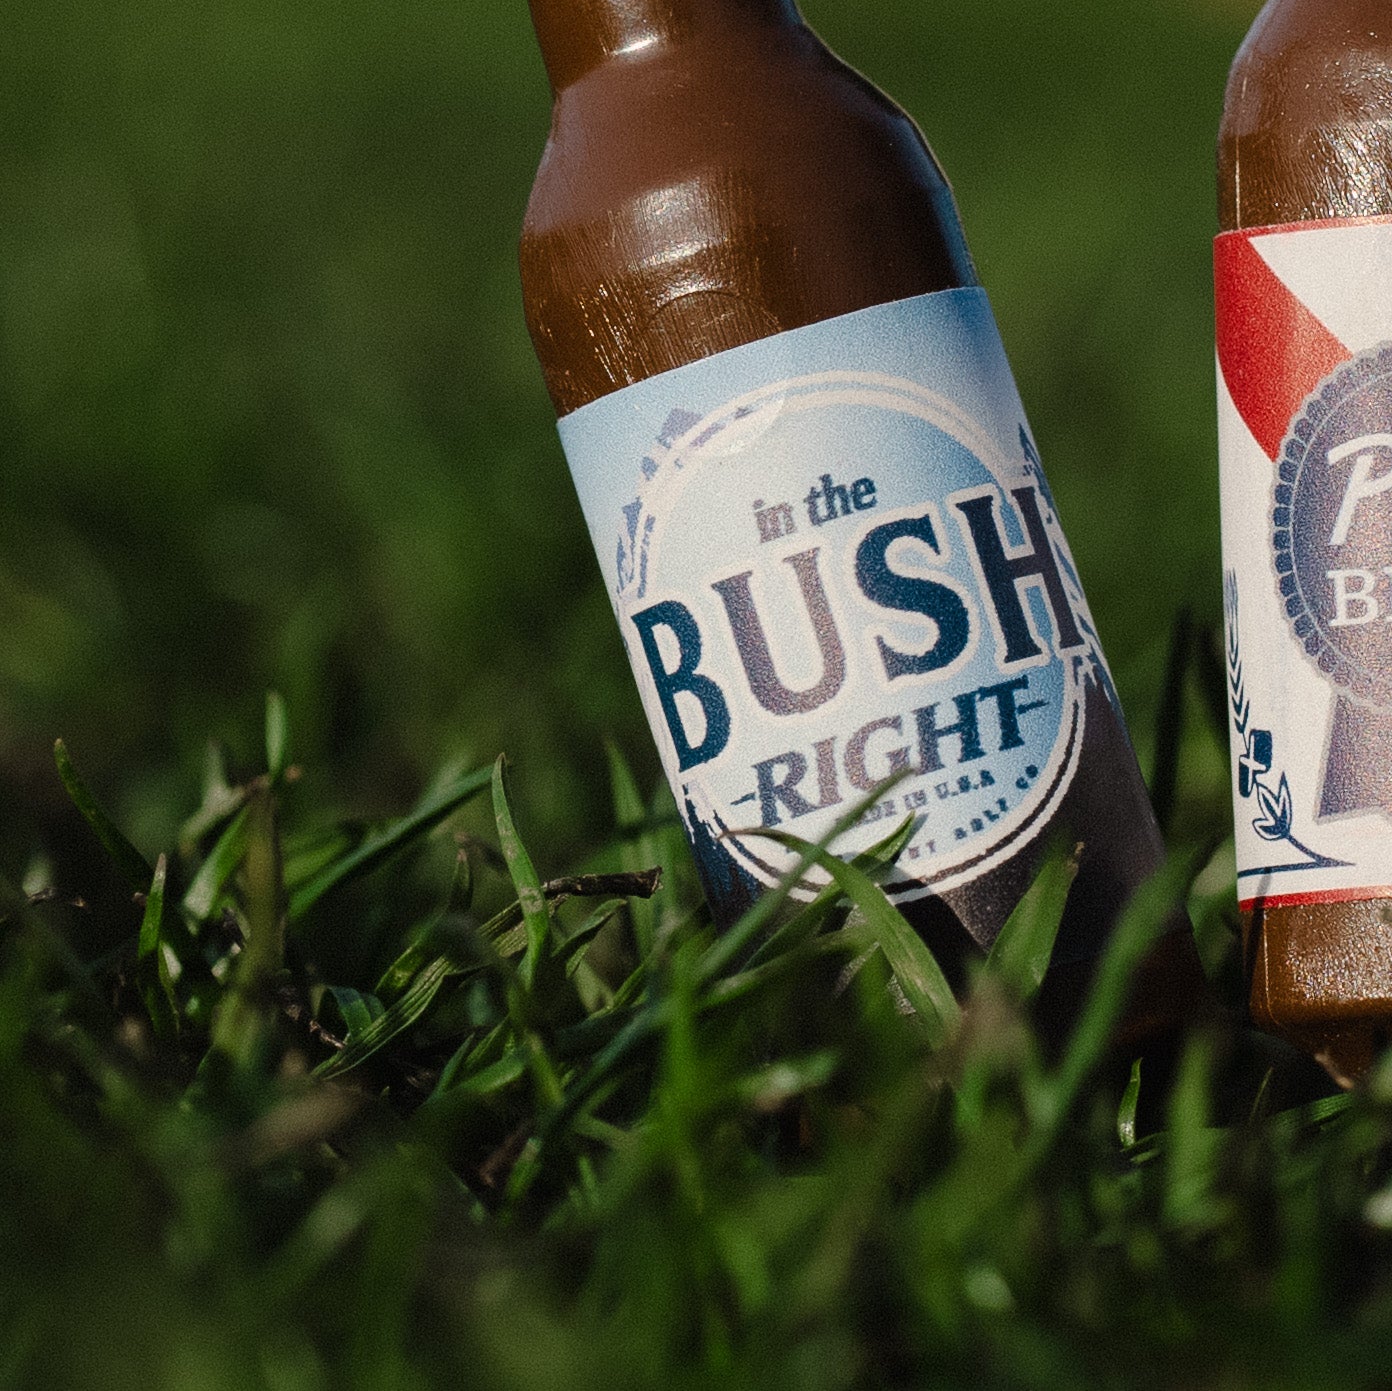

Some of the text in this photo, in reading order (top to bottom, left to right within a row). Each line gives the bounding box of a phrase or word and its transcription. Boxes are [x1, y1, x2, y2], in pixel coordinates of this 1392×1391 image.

[752, 473, 878, 543] in the
[631, 485, 1085, 774] BUSH
